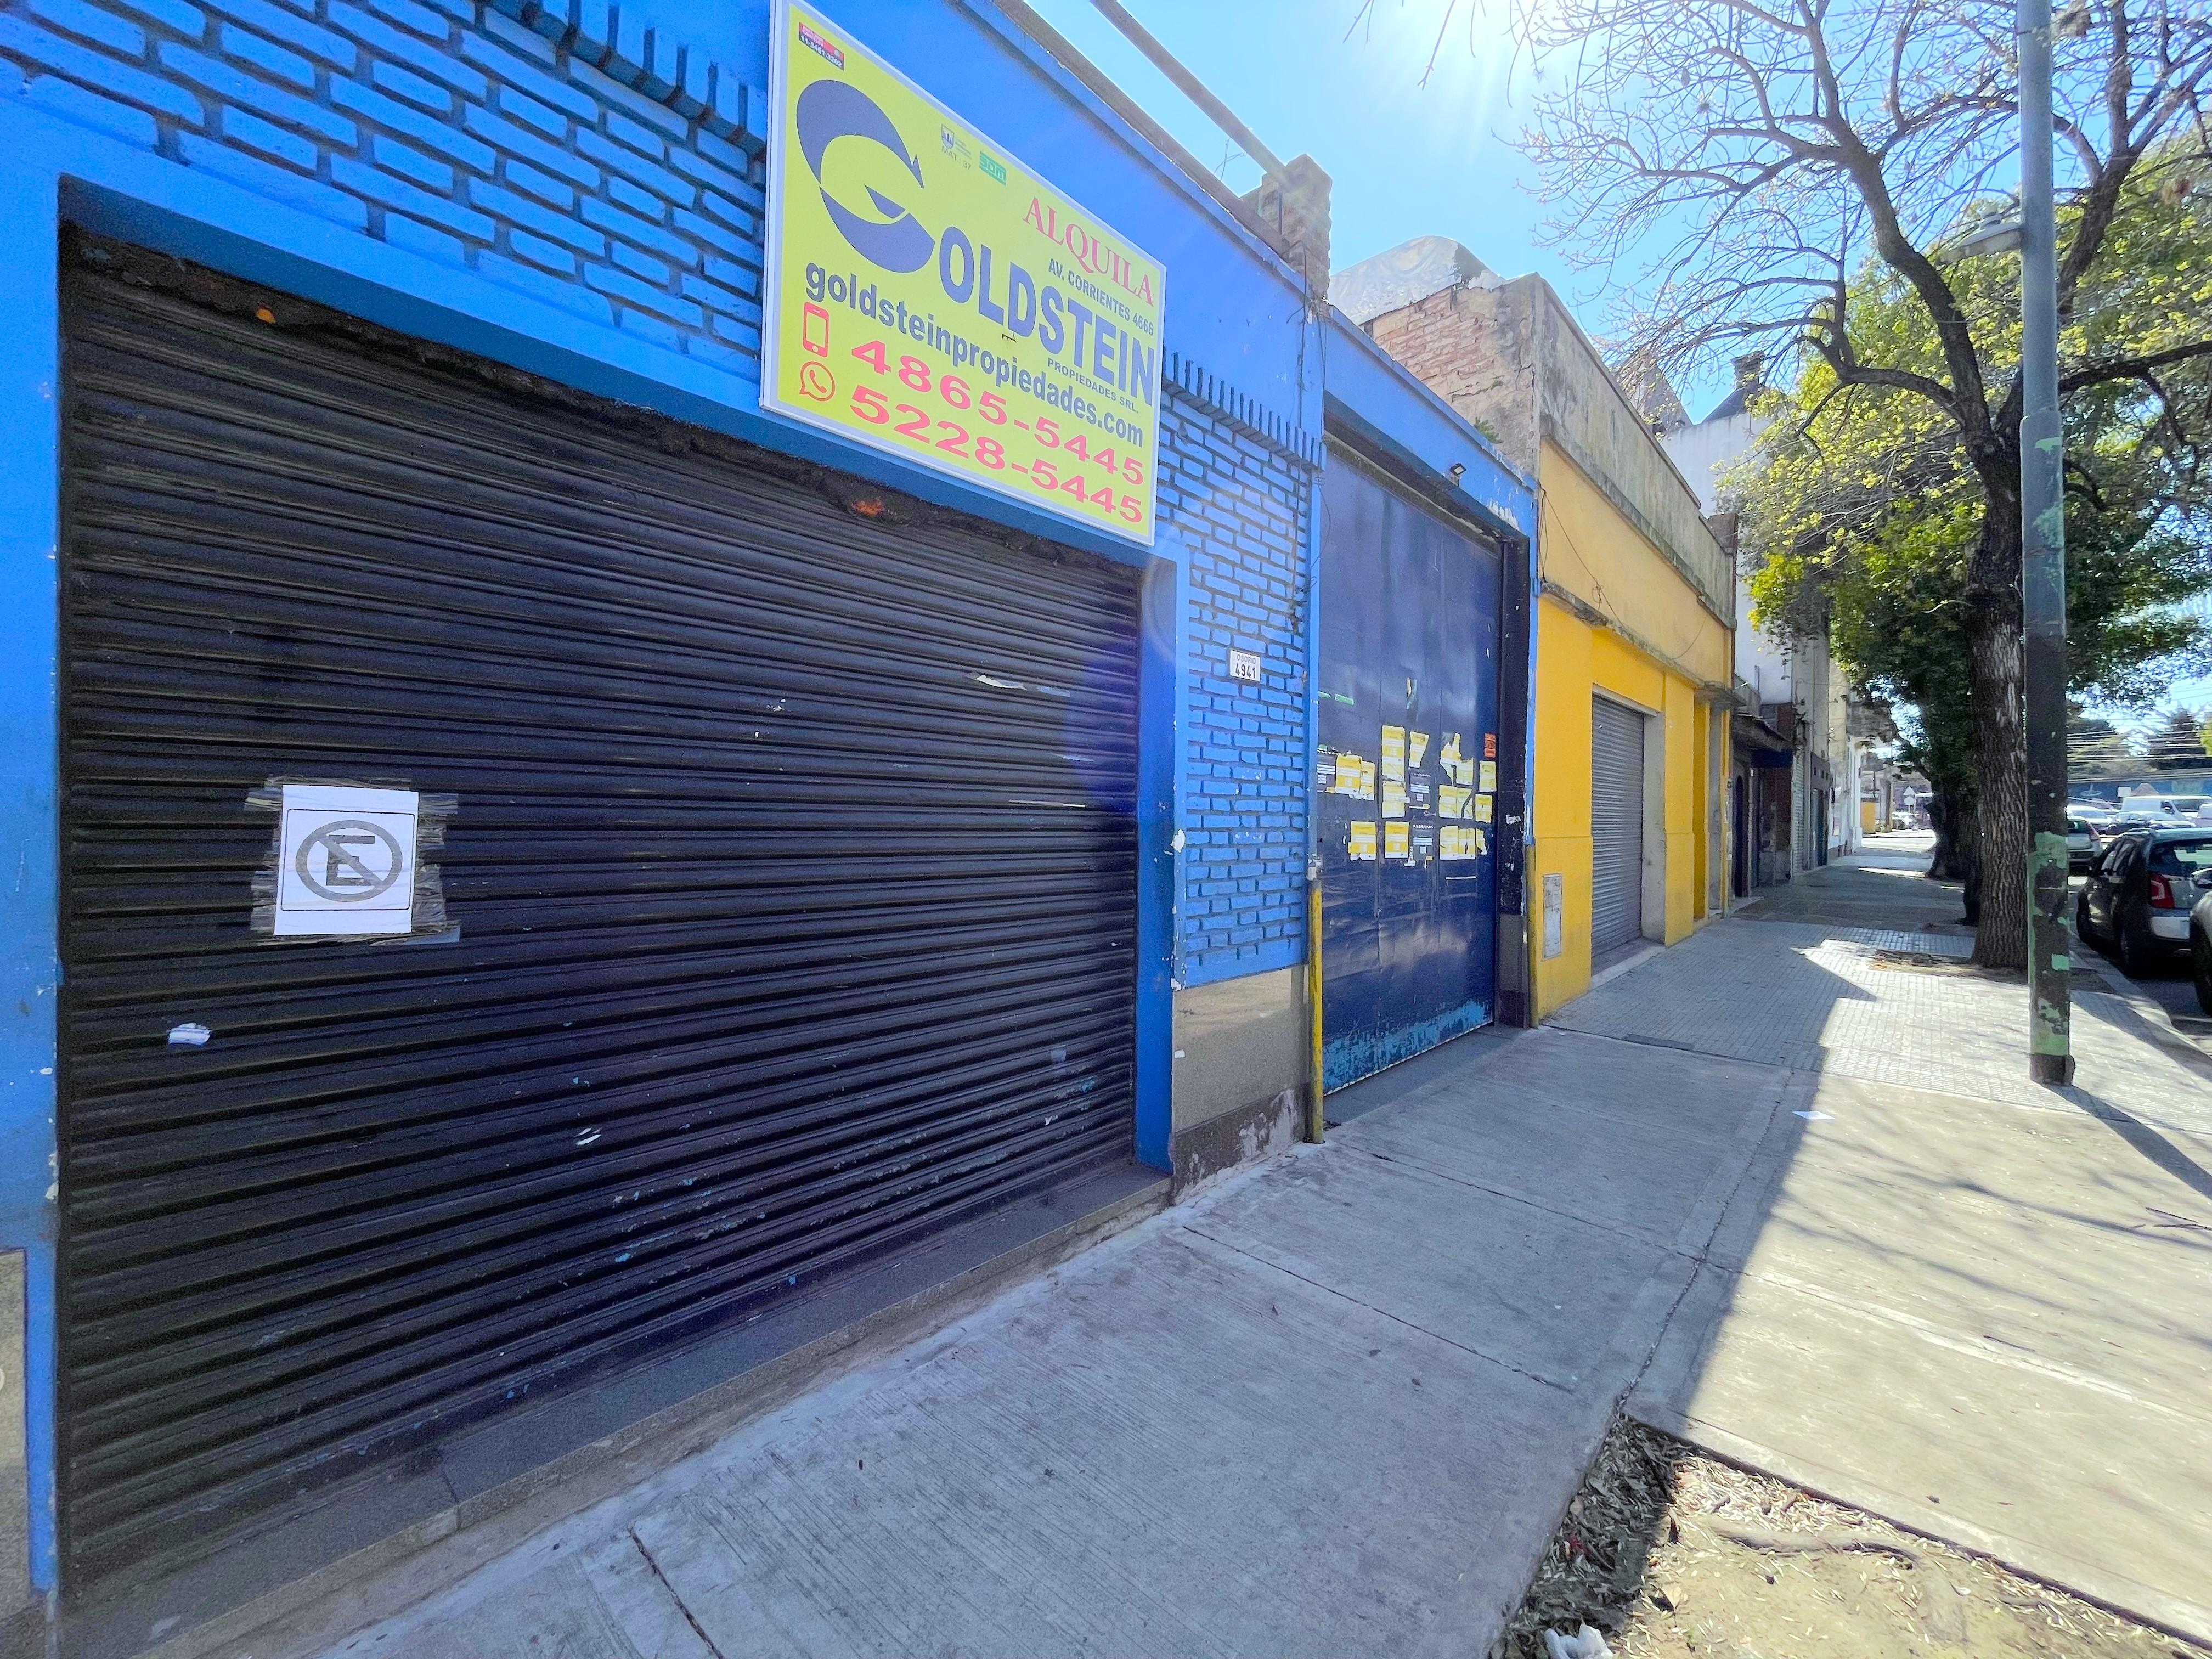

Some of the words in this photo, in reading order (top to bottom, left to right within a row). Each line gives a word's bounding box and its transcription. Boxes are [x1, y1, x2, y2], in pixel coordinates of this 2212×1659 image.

[1022, 197, 1154, 307] ALQUILA
[1048, 258, 1065, 281] AV.
[1068, 270, 1131, 322] CORRIENTES
[1132, 313, 1153, 336] 4666
[806, 262, 1144, 449] goldsteinpropiedades.com
[1047, 357, 1117, 402] PROPIEDADES
[1119, 398, 1139, 414] SRL.
[850, 385, 1143, 523] 5228-5445
[851, 340, 1144, 486] 4865-5445
[1235, 663, 1255, 679] 4941
